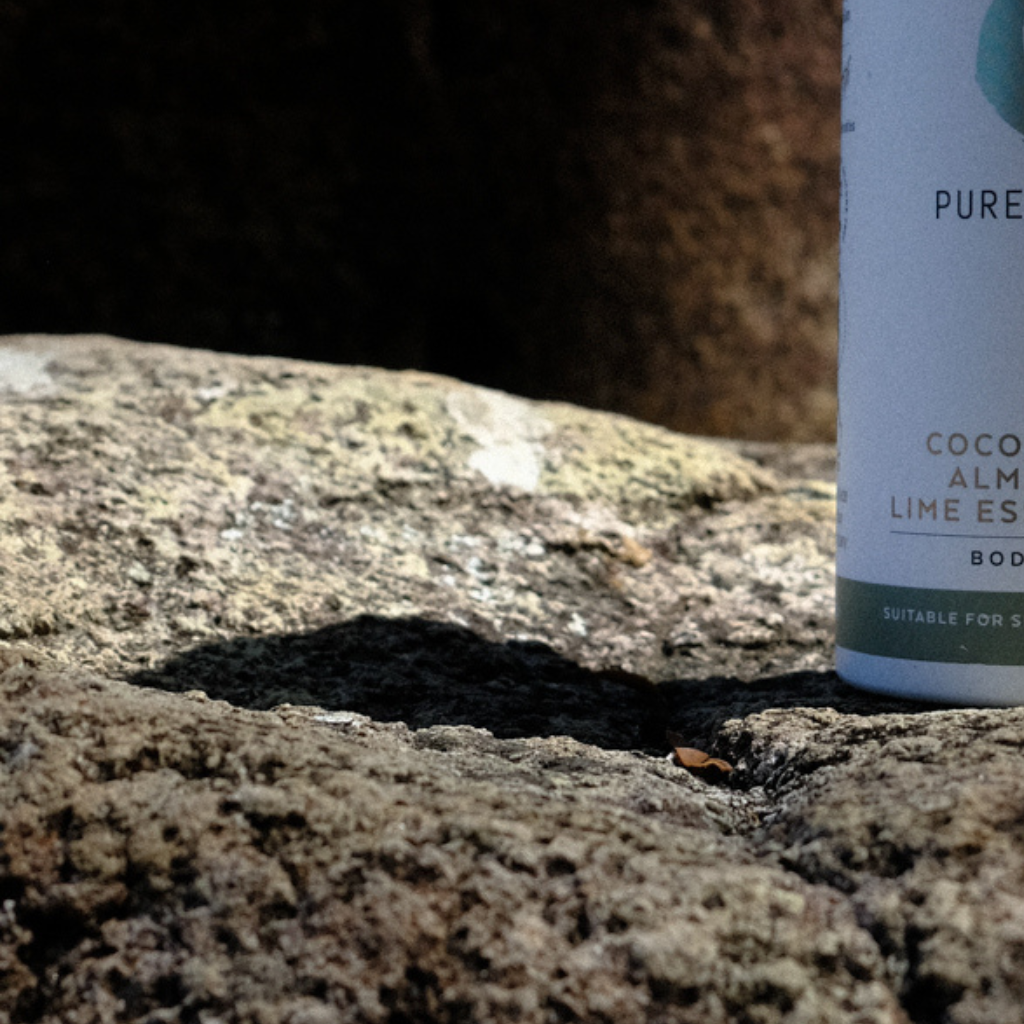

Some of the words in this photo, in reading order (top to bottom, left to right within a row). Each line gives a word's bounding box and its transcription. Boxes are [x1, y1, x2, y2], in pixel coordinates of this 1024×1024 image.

[935, 189, 1023, 219] PURE
[890, 496, 960, 521] LIME
[883, 606, 958, 626] SUITABLE
[965, 613, 1003, 627] FOR
